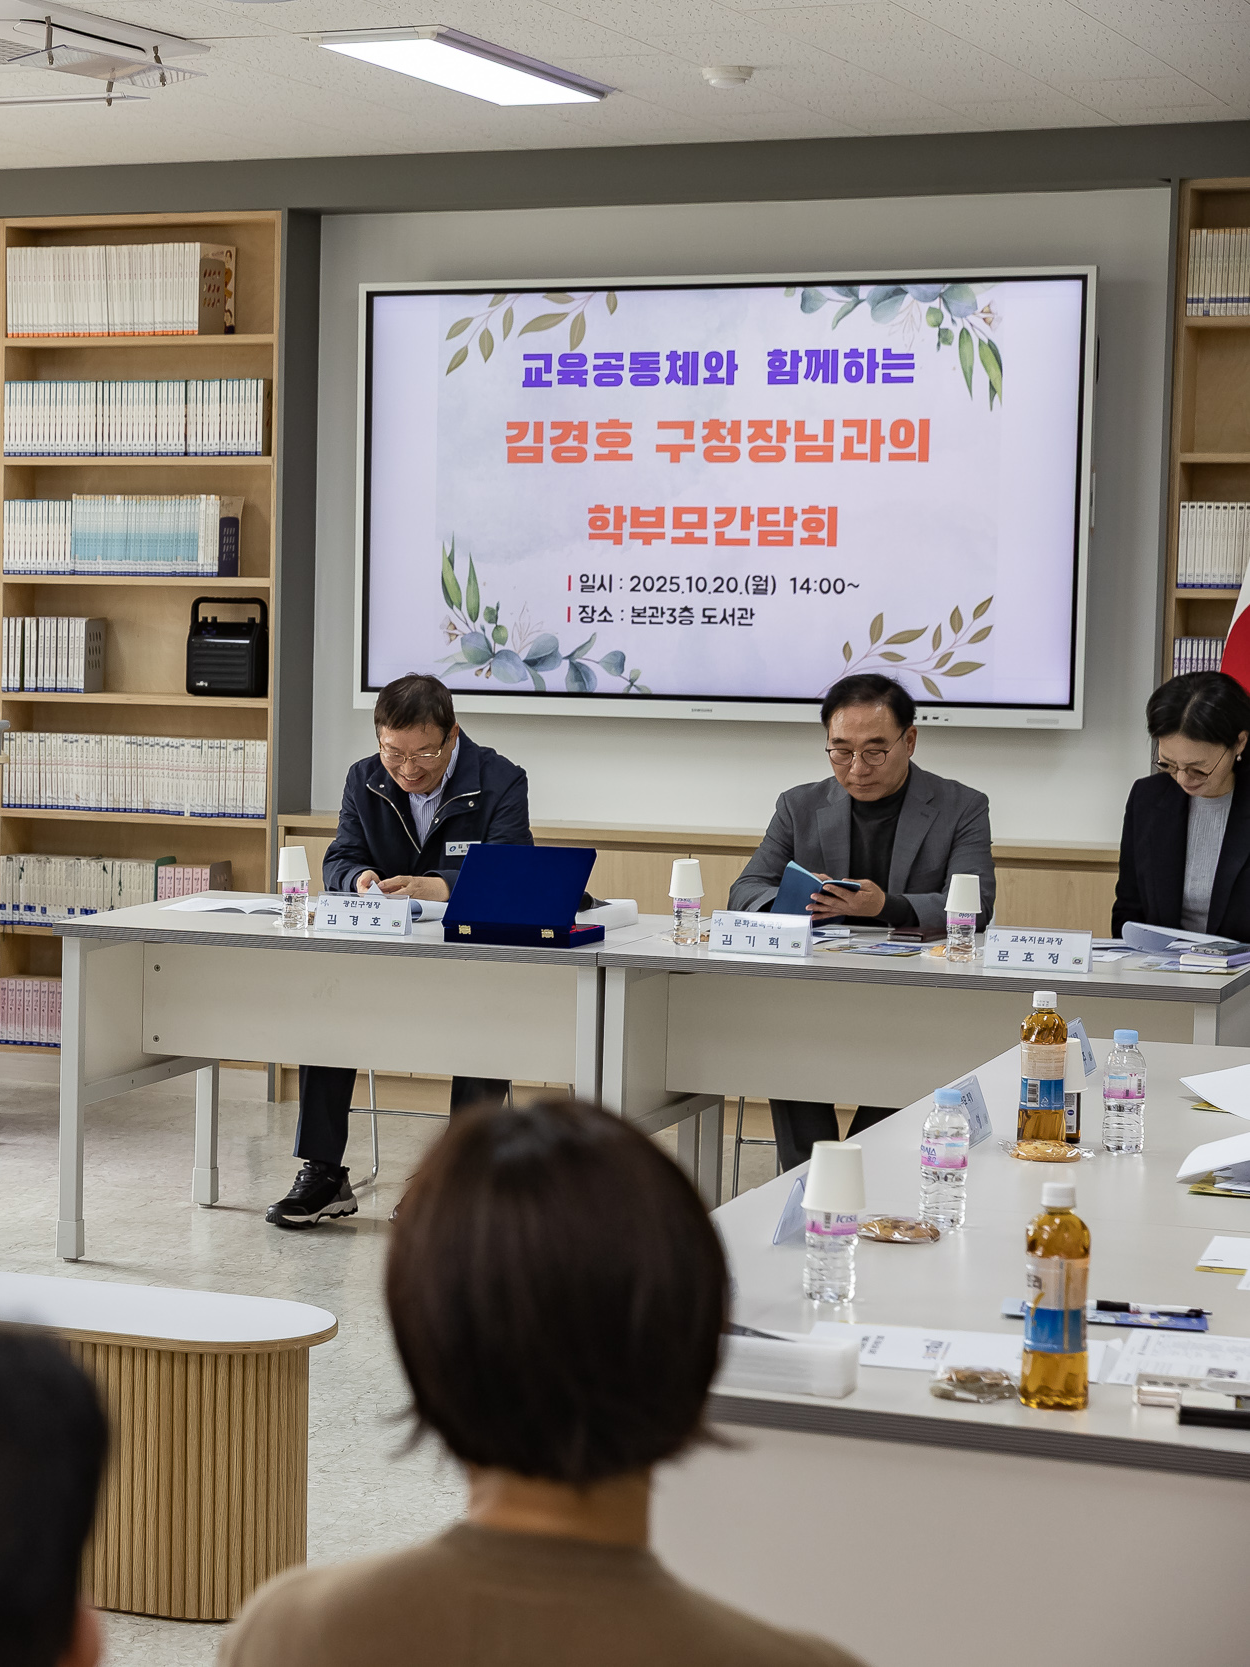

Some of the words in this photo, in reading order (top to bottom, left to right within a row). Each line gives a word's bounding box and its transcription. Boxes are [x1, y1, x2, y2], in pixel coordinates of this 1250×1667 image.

[522, 350, 738, 387] 교육공동체와
[767, 348, 915, 385] 함께하는
[506, 419, 633, 463] 김경호
[656, 419, 930, 463] 구청장님과의
[588, 505, 837, 547] 학부모간담회
[579, 573, 613, 594] 일시
[630, 575, 777, 596] 2025.10.20.(월)
[789, 577, 860, 595] 14:00~
[578, 605, 614, 624] 장소
[630, 605, 694, 626] 본관3층
[700, 607, 756, 627] 도서관
[327, 914, 381, 926] 김경호
[1010, 935, 1063, 946] 교육지원과장
[997, 949, 1060, 965] 문효정
